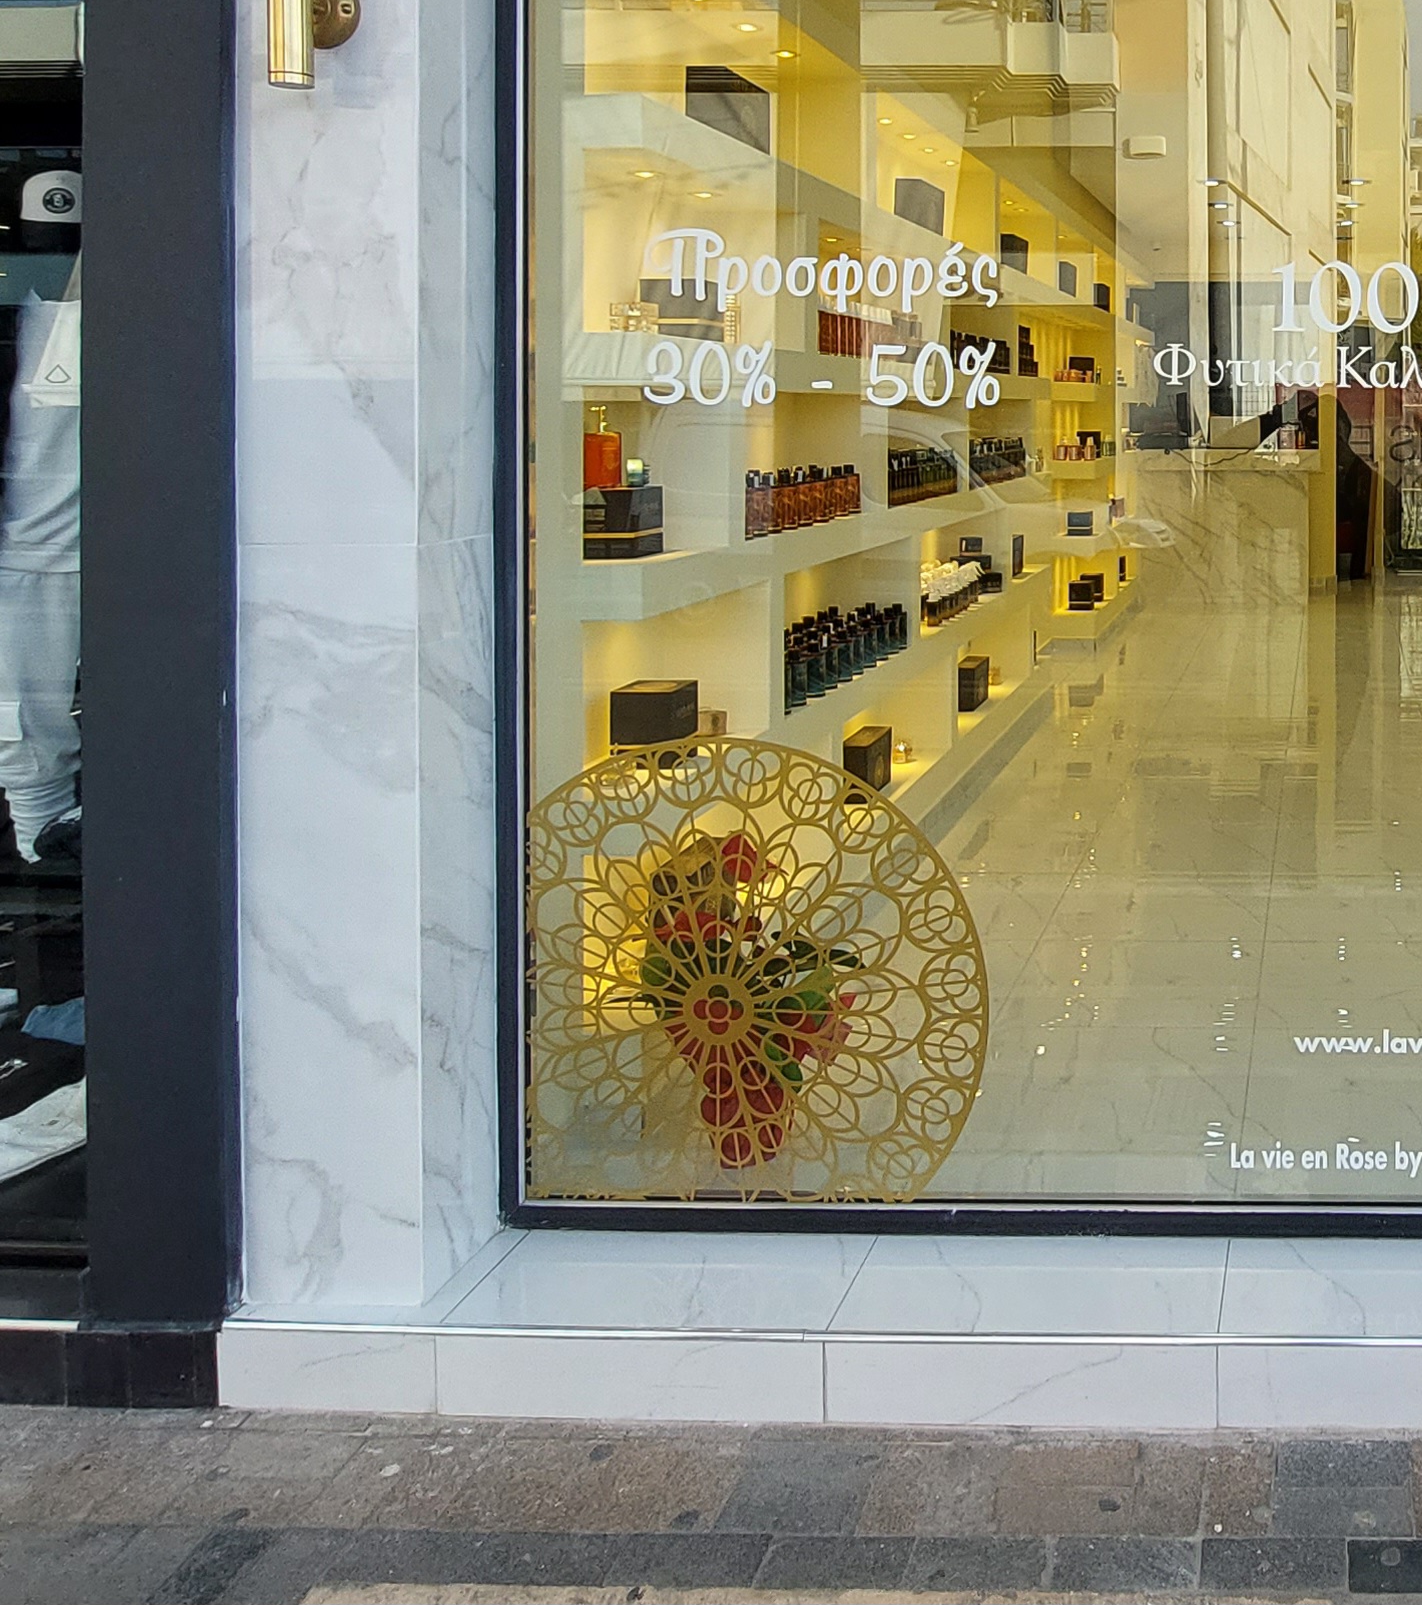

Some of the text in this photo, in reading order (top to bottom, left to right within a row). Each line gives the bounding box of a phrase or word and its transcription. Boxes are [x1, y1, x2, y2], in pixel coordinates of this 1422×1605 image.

[643, 227, 999, 313] Προσφορές
[643, 340, 777, 409] 30%
[865, 339, 1001, 410] 50%
[1152, 342, 1323, 388] Φυτικά
[1230, 1142, 1256, 1170] La
[1261, 1142, 1296, 1170] vie
[1301, 1150, 1328, 1170] en
[1335, 1143, 1388, 1171] Rose
[1394, 1141, 1422, 1178] by
